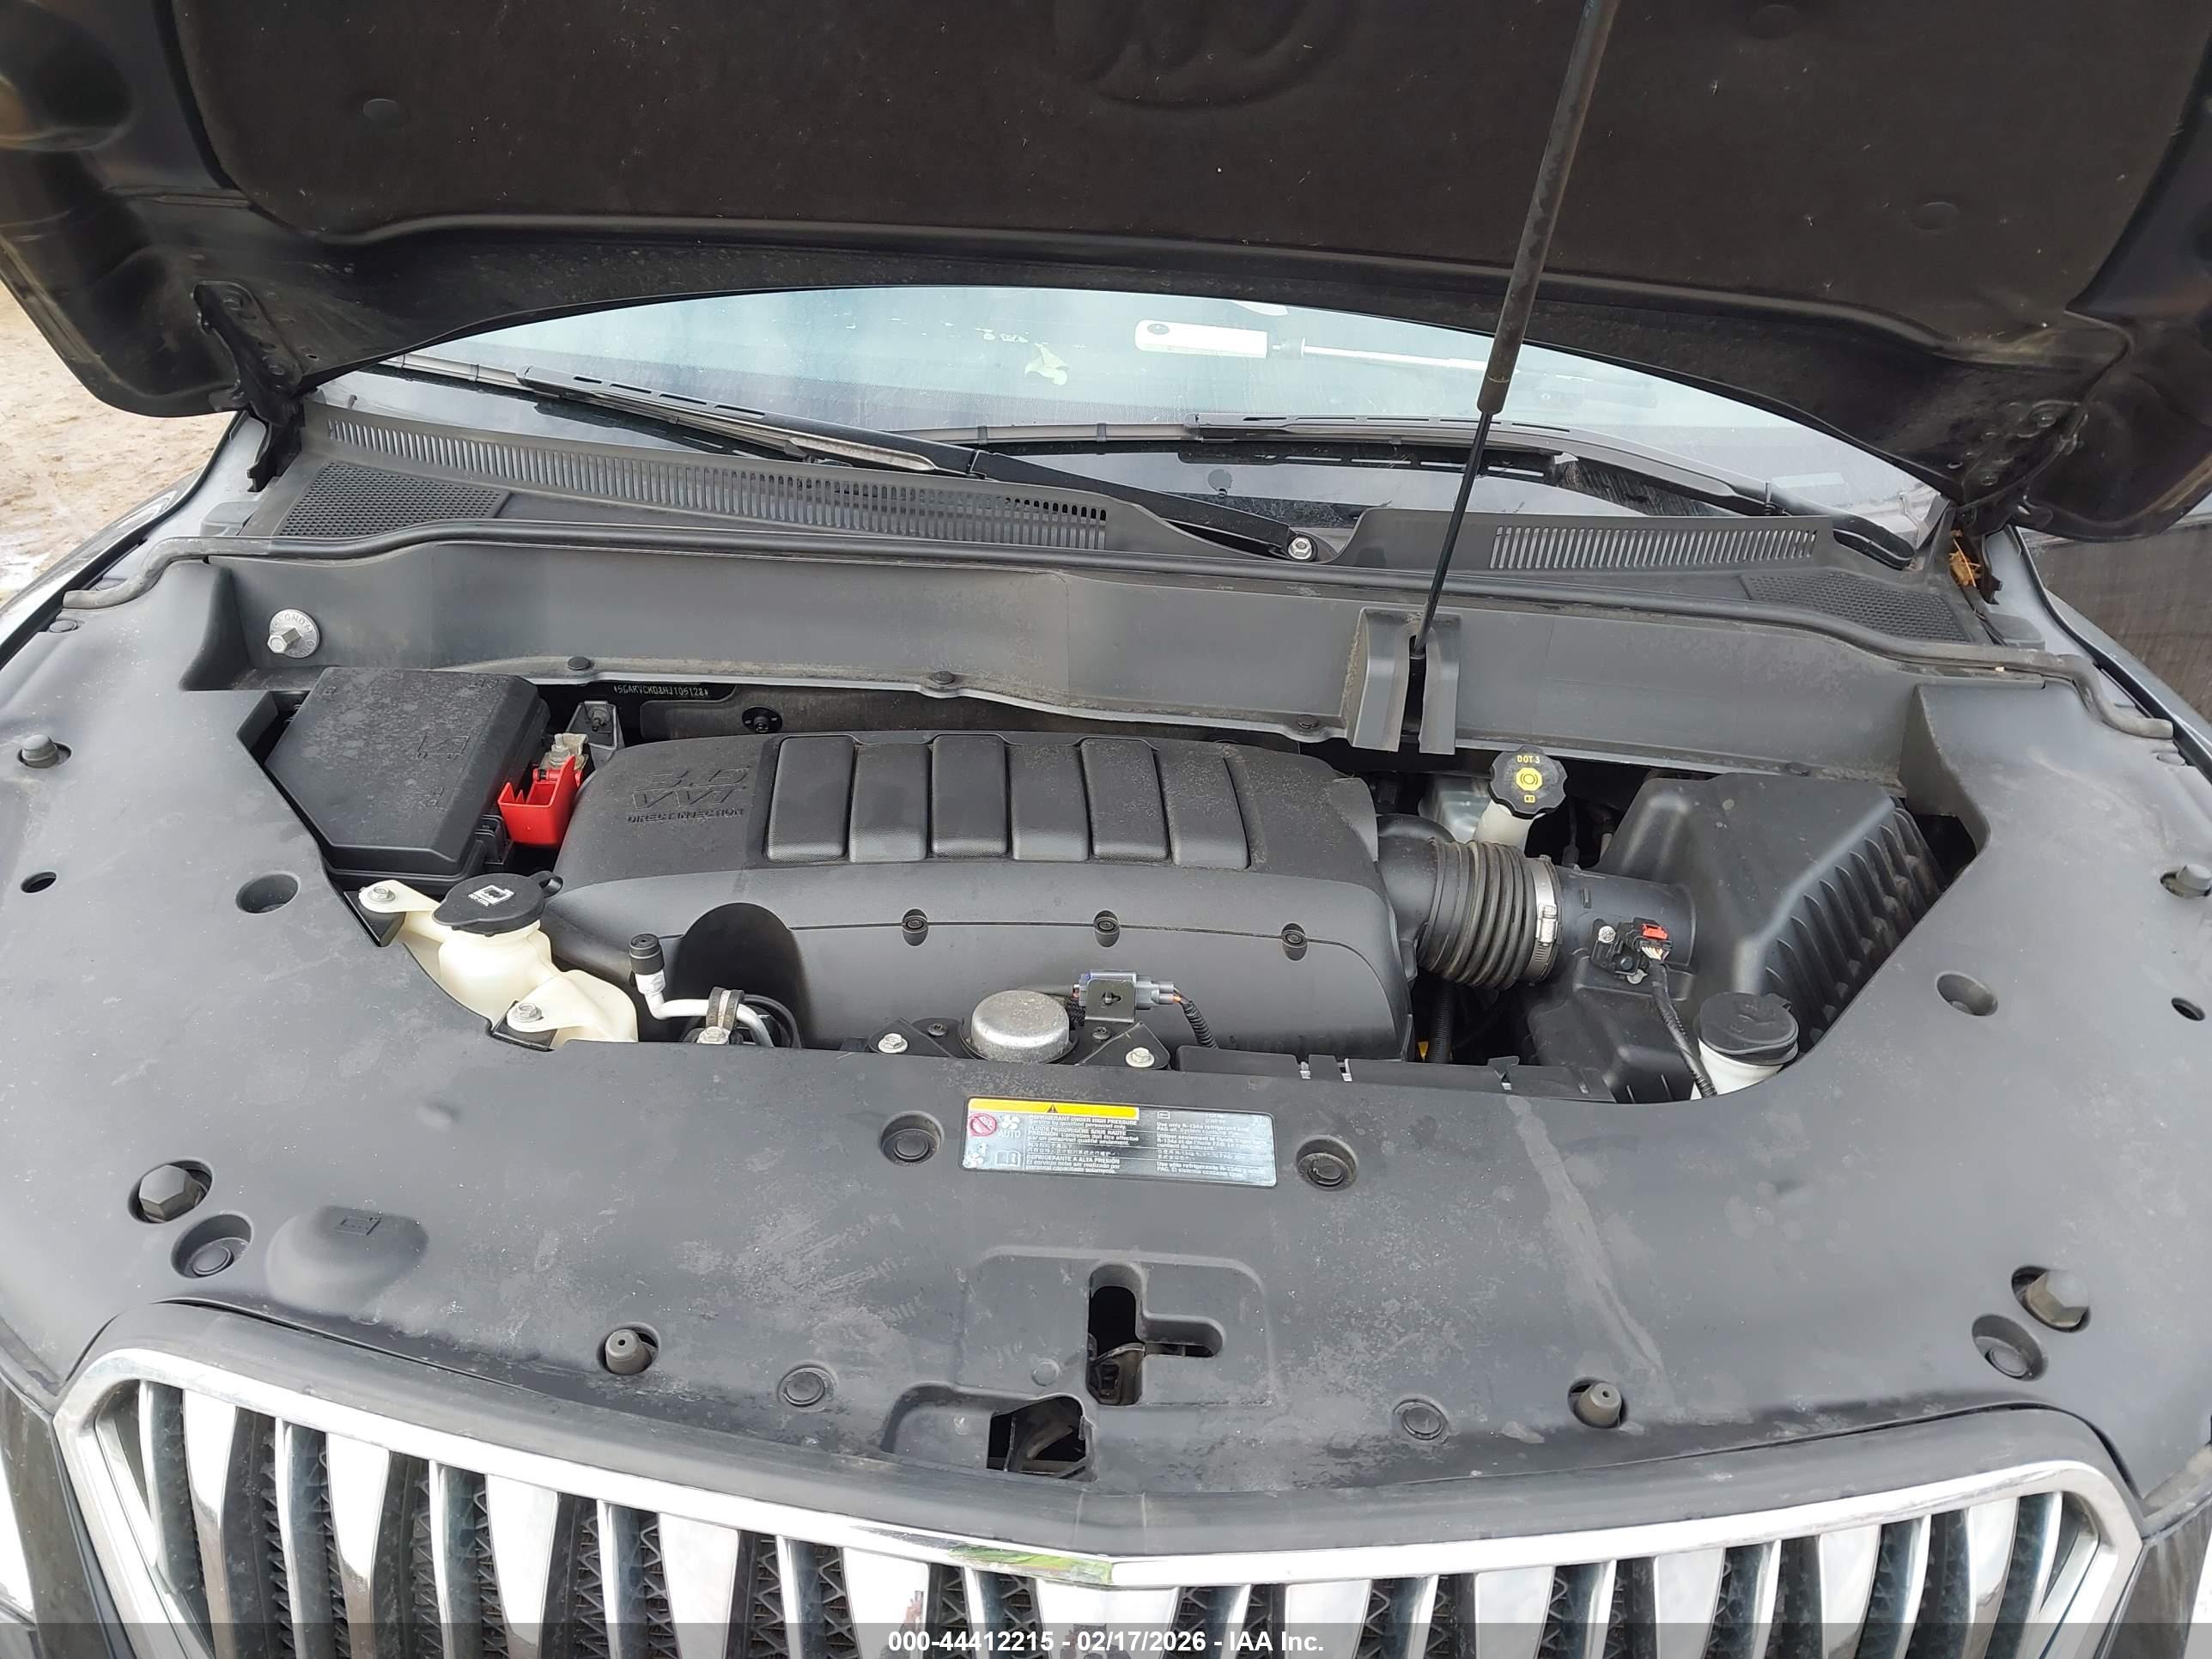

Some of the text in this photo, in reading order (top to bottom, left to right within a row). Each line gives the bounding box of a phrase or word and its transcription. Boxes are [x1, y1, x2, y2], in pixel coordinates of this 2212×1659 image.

[1516, 754, 1540, 764] DOT 3
[677, 809, 744, 820] INJECTION
